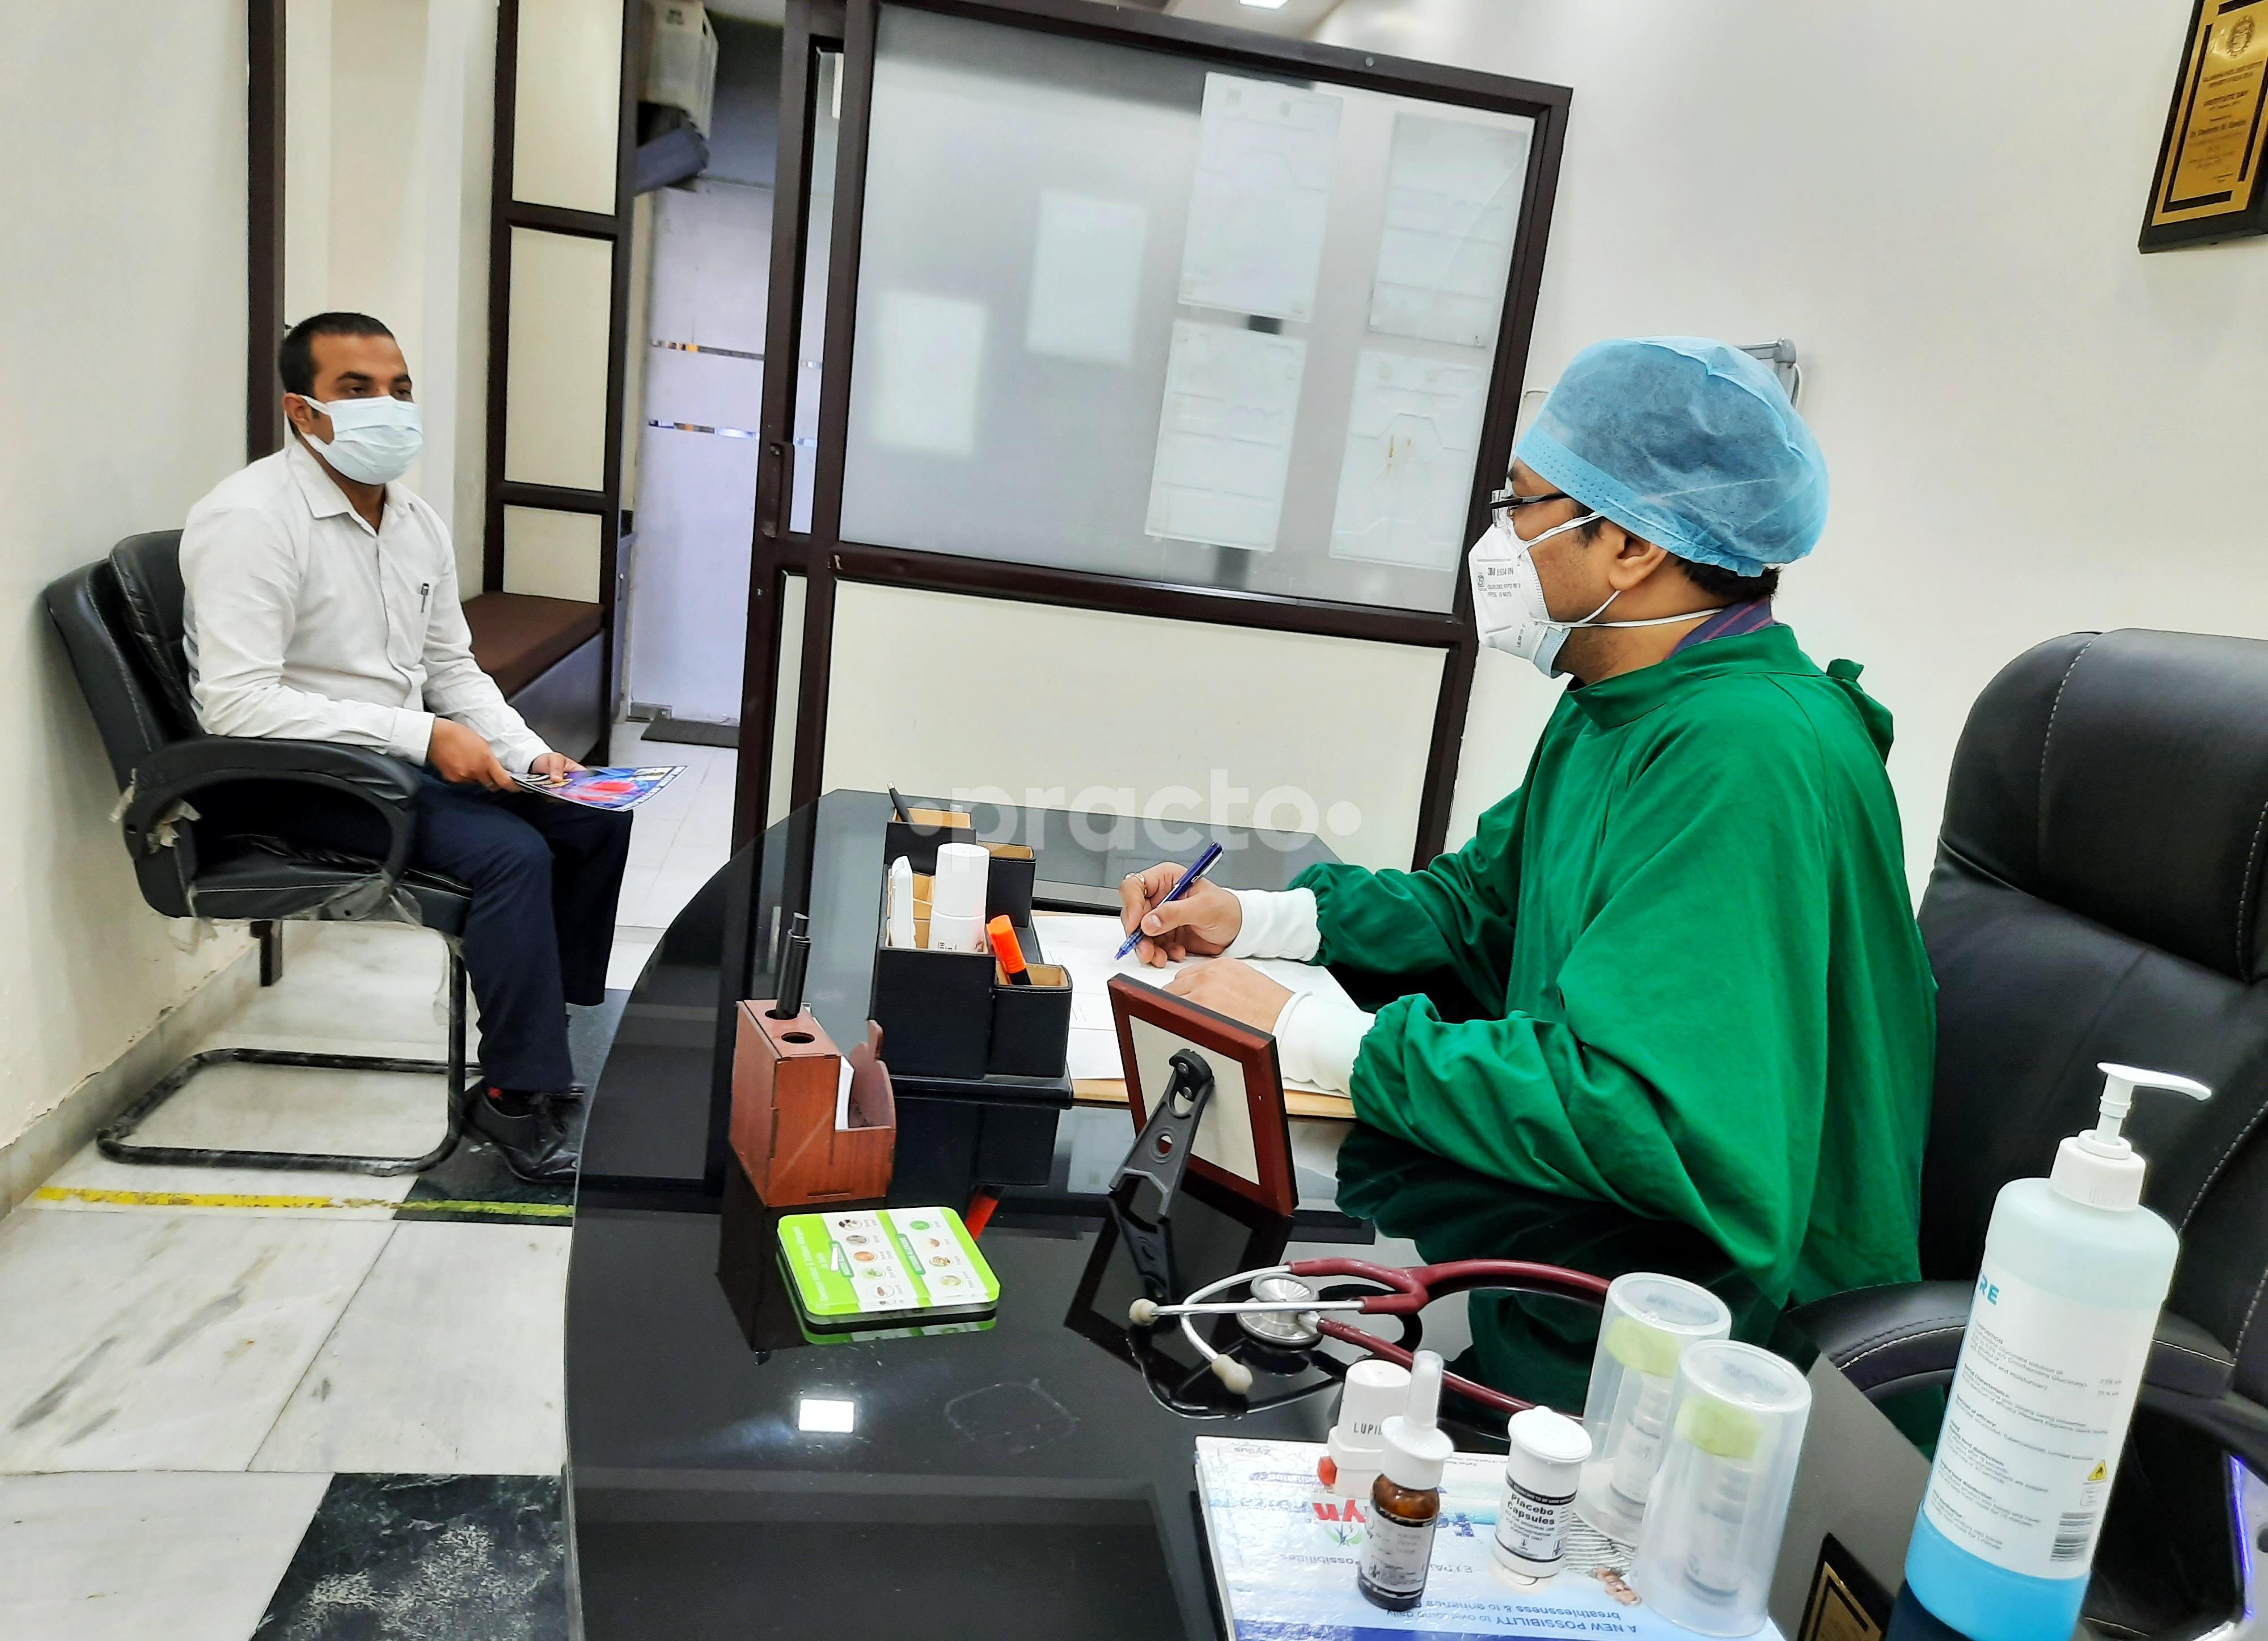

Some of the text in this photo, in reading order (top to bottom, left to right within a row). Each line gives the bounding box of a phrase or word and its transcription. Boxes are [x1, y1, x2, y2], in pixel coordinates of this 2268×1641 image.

[1979, 1274, 2000, 1305] RE
[1511, 1492, 1554, 1516] Placebo
[1508, 1500, 1555, 1525] Capsules
[1504, 1605, 1512, 1613] &
[1516, 1605, 1622, 1621] breathlessness
[1496, 1617, 1586, 1630] POSSIBILITY
[1591, 1622, 1624, 1632] NEW
[1626, 1624, 1636, 1633] A
